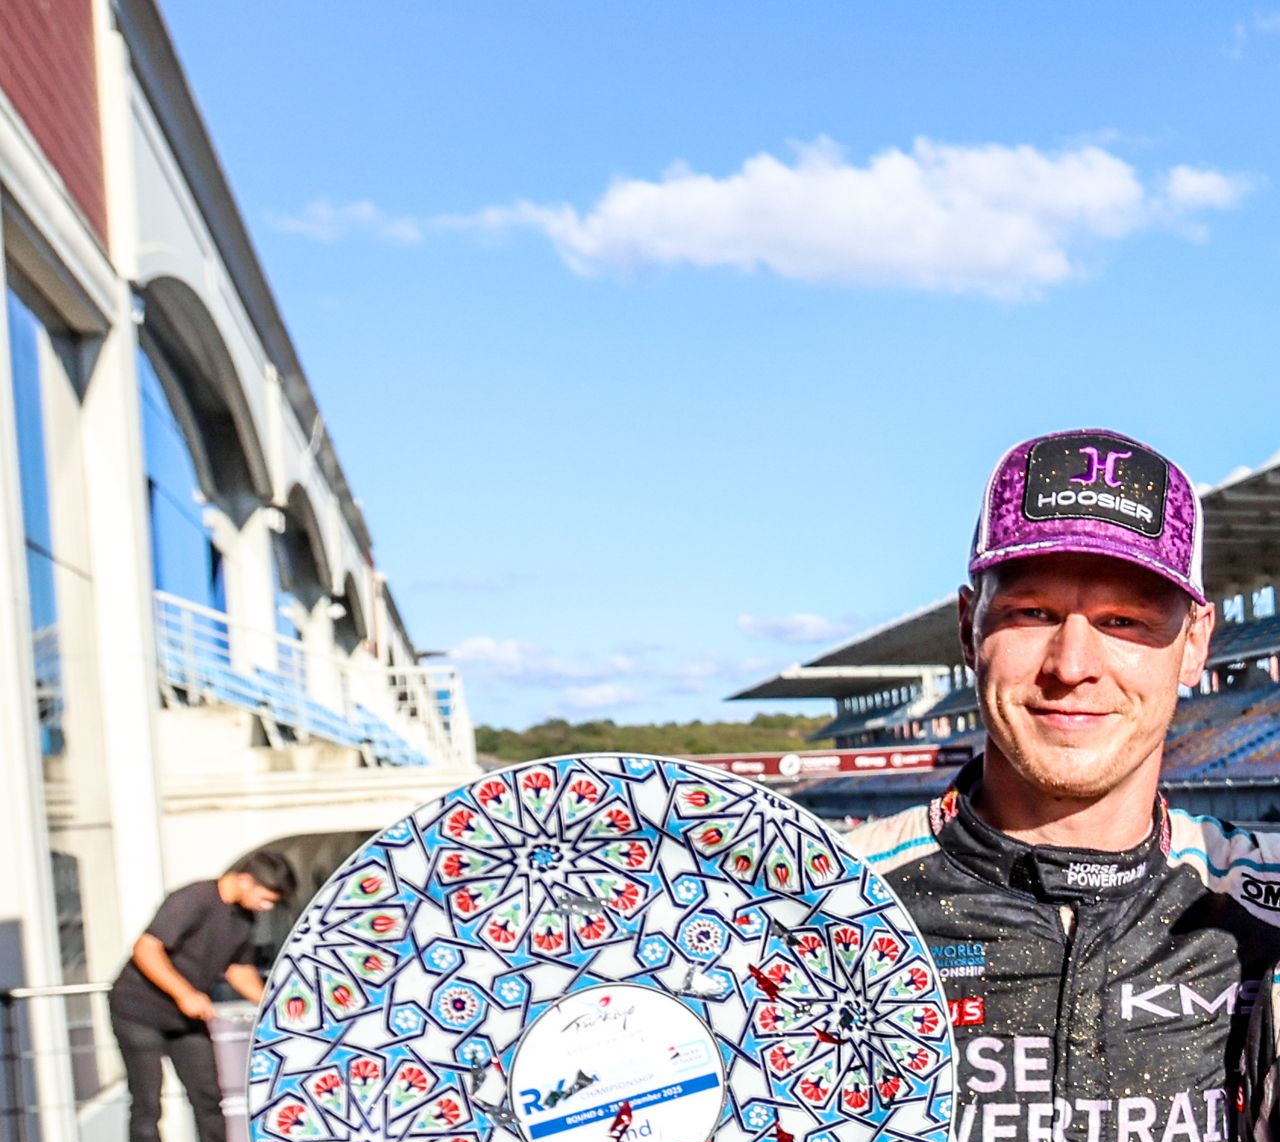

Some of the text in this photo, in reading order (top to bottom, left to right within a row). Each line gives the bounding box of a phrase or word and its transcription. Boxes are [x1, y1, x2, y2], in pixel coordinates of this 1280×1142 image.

[1039, 488, 1153, 523] HOOSIER
[1069, 862, 1118, 874] HORSE
[930, 944, 984, 958] WORLD
[566, 1108, 597, 1126] ROUND
[662, 1084, 684, 1099] 2025
